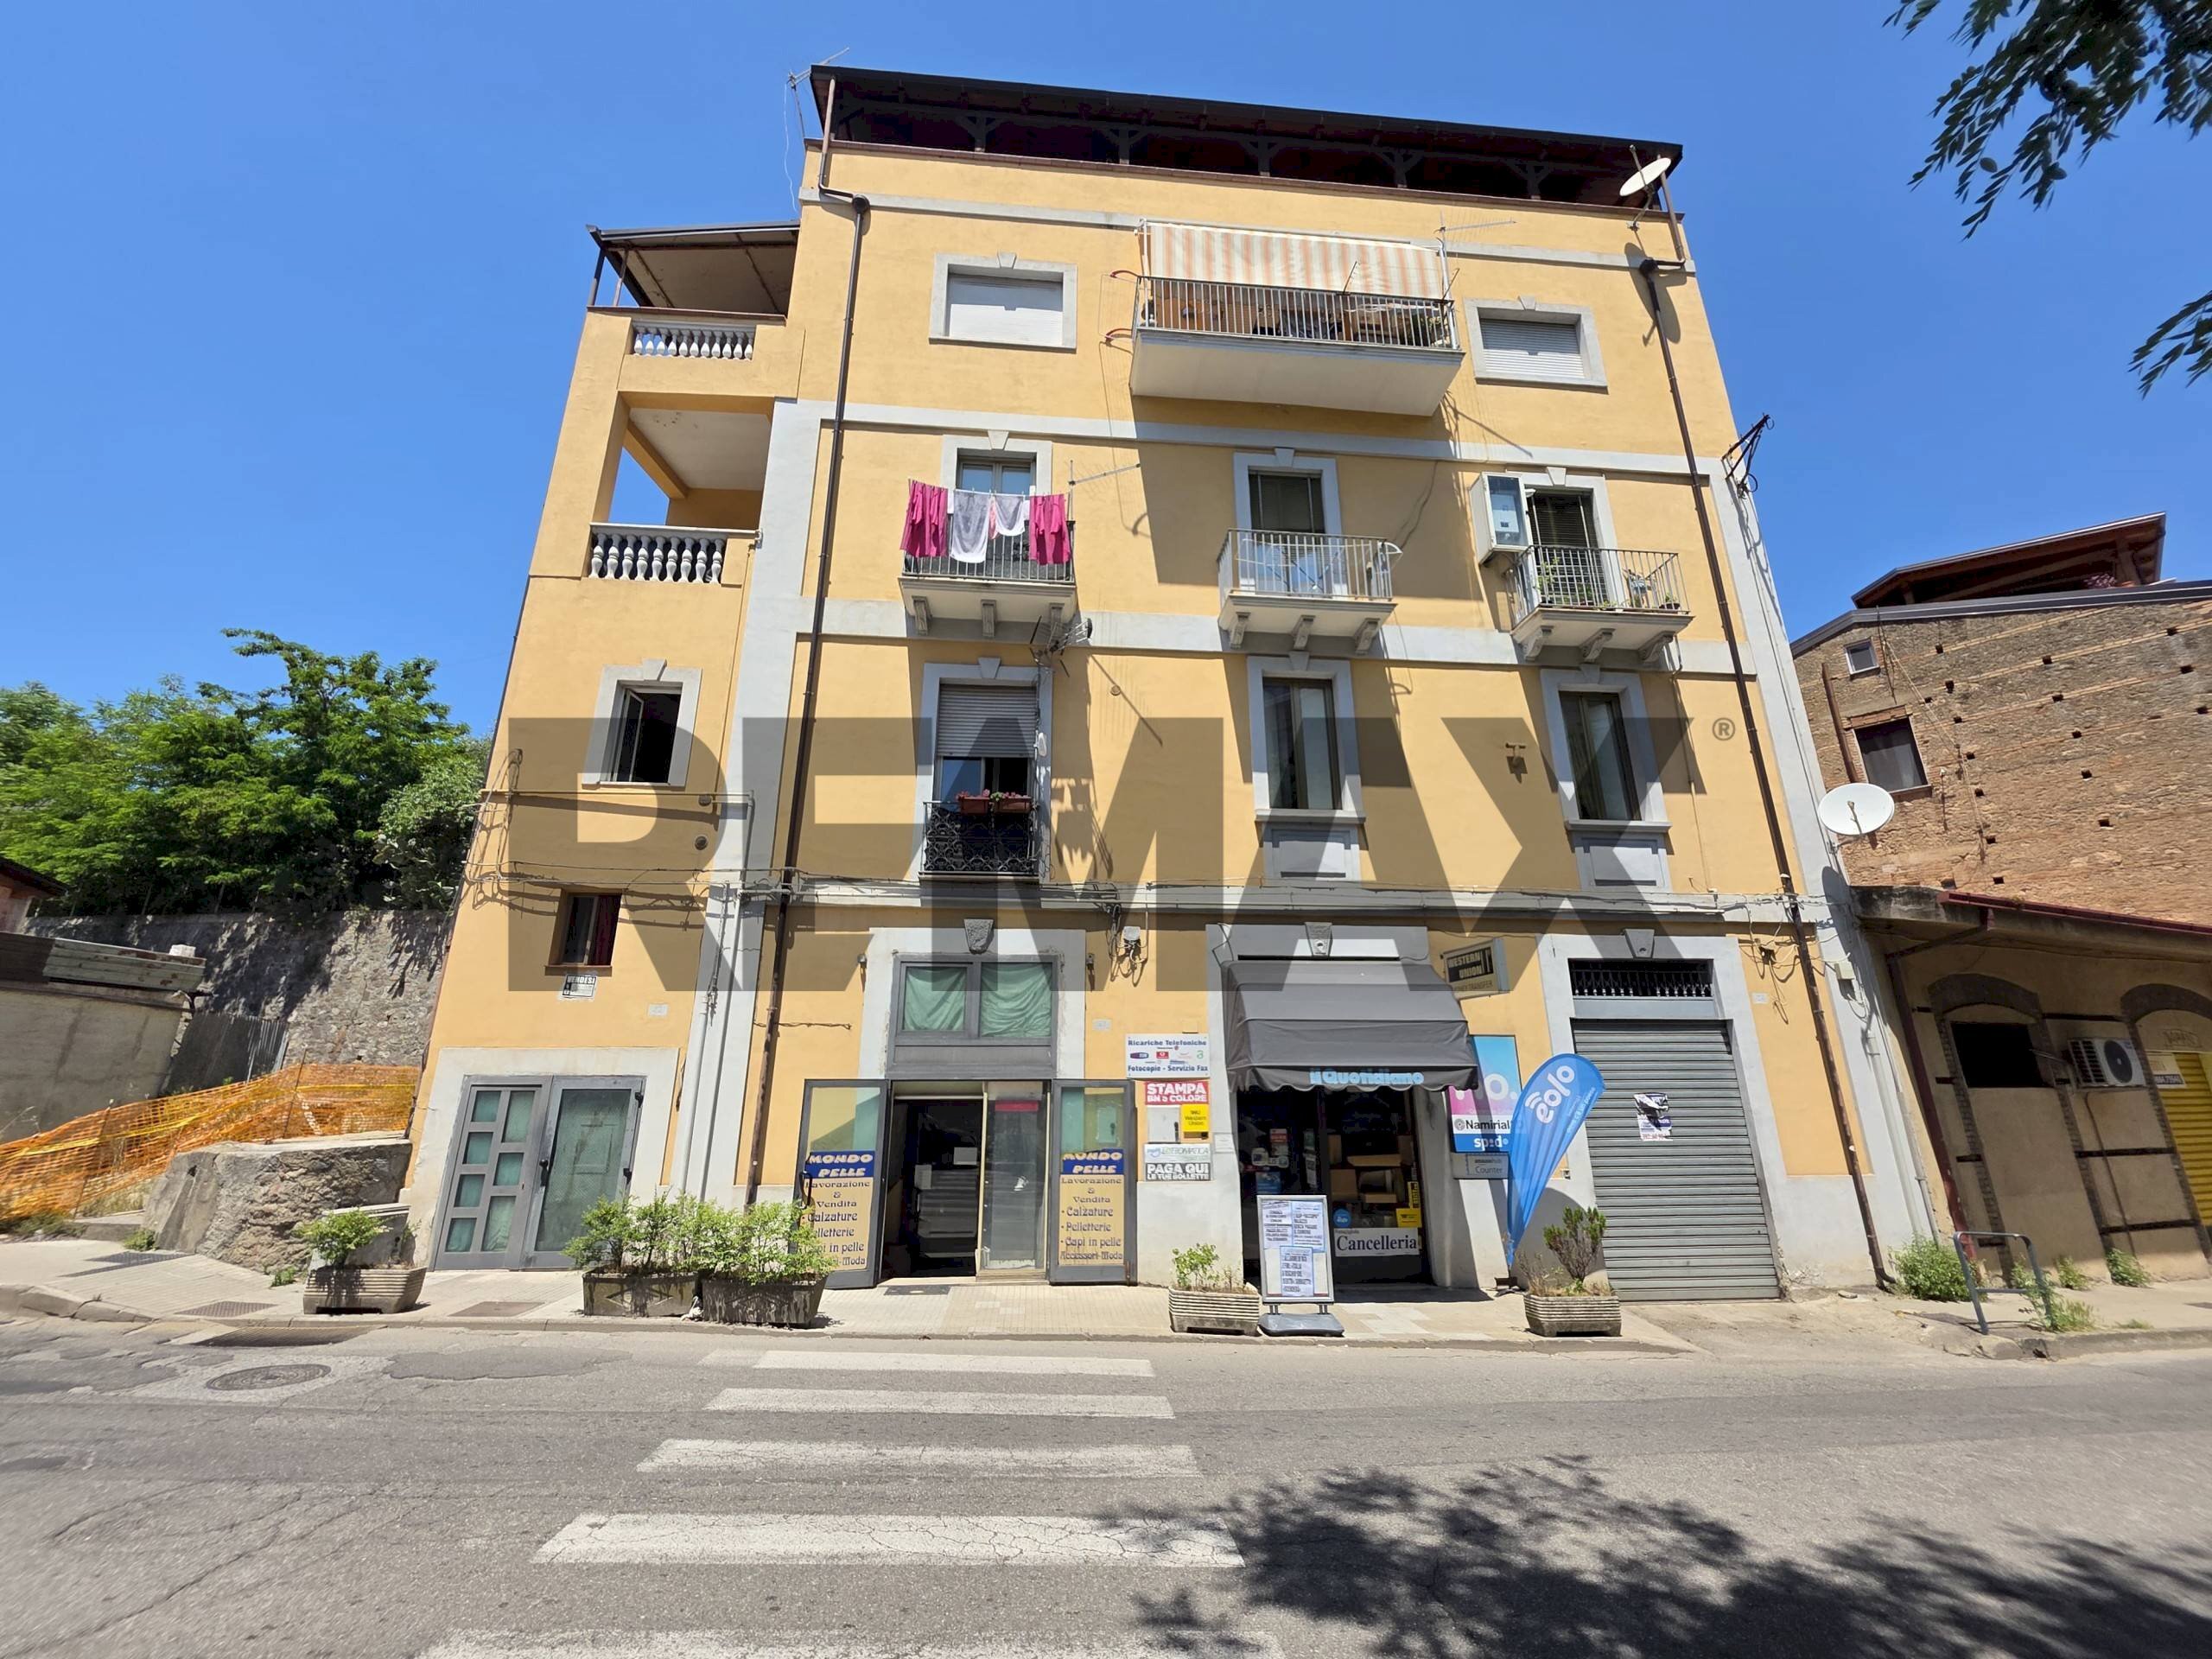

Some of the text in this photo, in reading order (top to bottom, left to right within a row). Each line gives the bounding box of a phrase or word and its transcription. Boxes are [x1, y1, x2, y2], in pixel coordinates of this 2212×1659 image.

[1449, 951, 1481, 968] WESTERN
[1459, 964, 1483, 979] UNION
[1128, 1065, 1161, 1073] Fotocopie
[1147, 1083, 1207, 1095] STAMPA
[1465, 1119, 1510, 1130] Namirial
[809, 1154, 874, 1164] MONDO
[1063, 1152, 1122, 1160] MONDO
[818, 1168, 866, 1177] PELLE
[1072, 1165, 1117, 1174] PELLE
[1147, 1163, 1209, 1173] PAGA QUI
[805, 1180, 870, 1189] Lavorazione
[807, 1211, 858, 1223] Calzature
[1066, 1206, 1114, 1217] Calzature
[1065, 1221, 1111, 1232] Pelletterie
[830, 1243, 839, 1253] in
[841, 1242, 864, 1254] pelle
[1065, 1236, 1122, 1249] Capi in pelle
[1337, 1235, 1417, 1251] Cancelleria
[1060, 1250, 1122, 1260] Accessori-Moda
